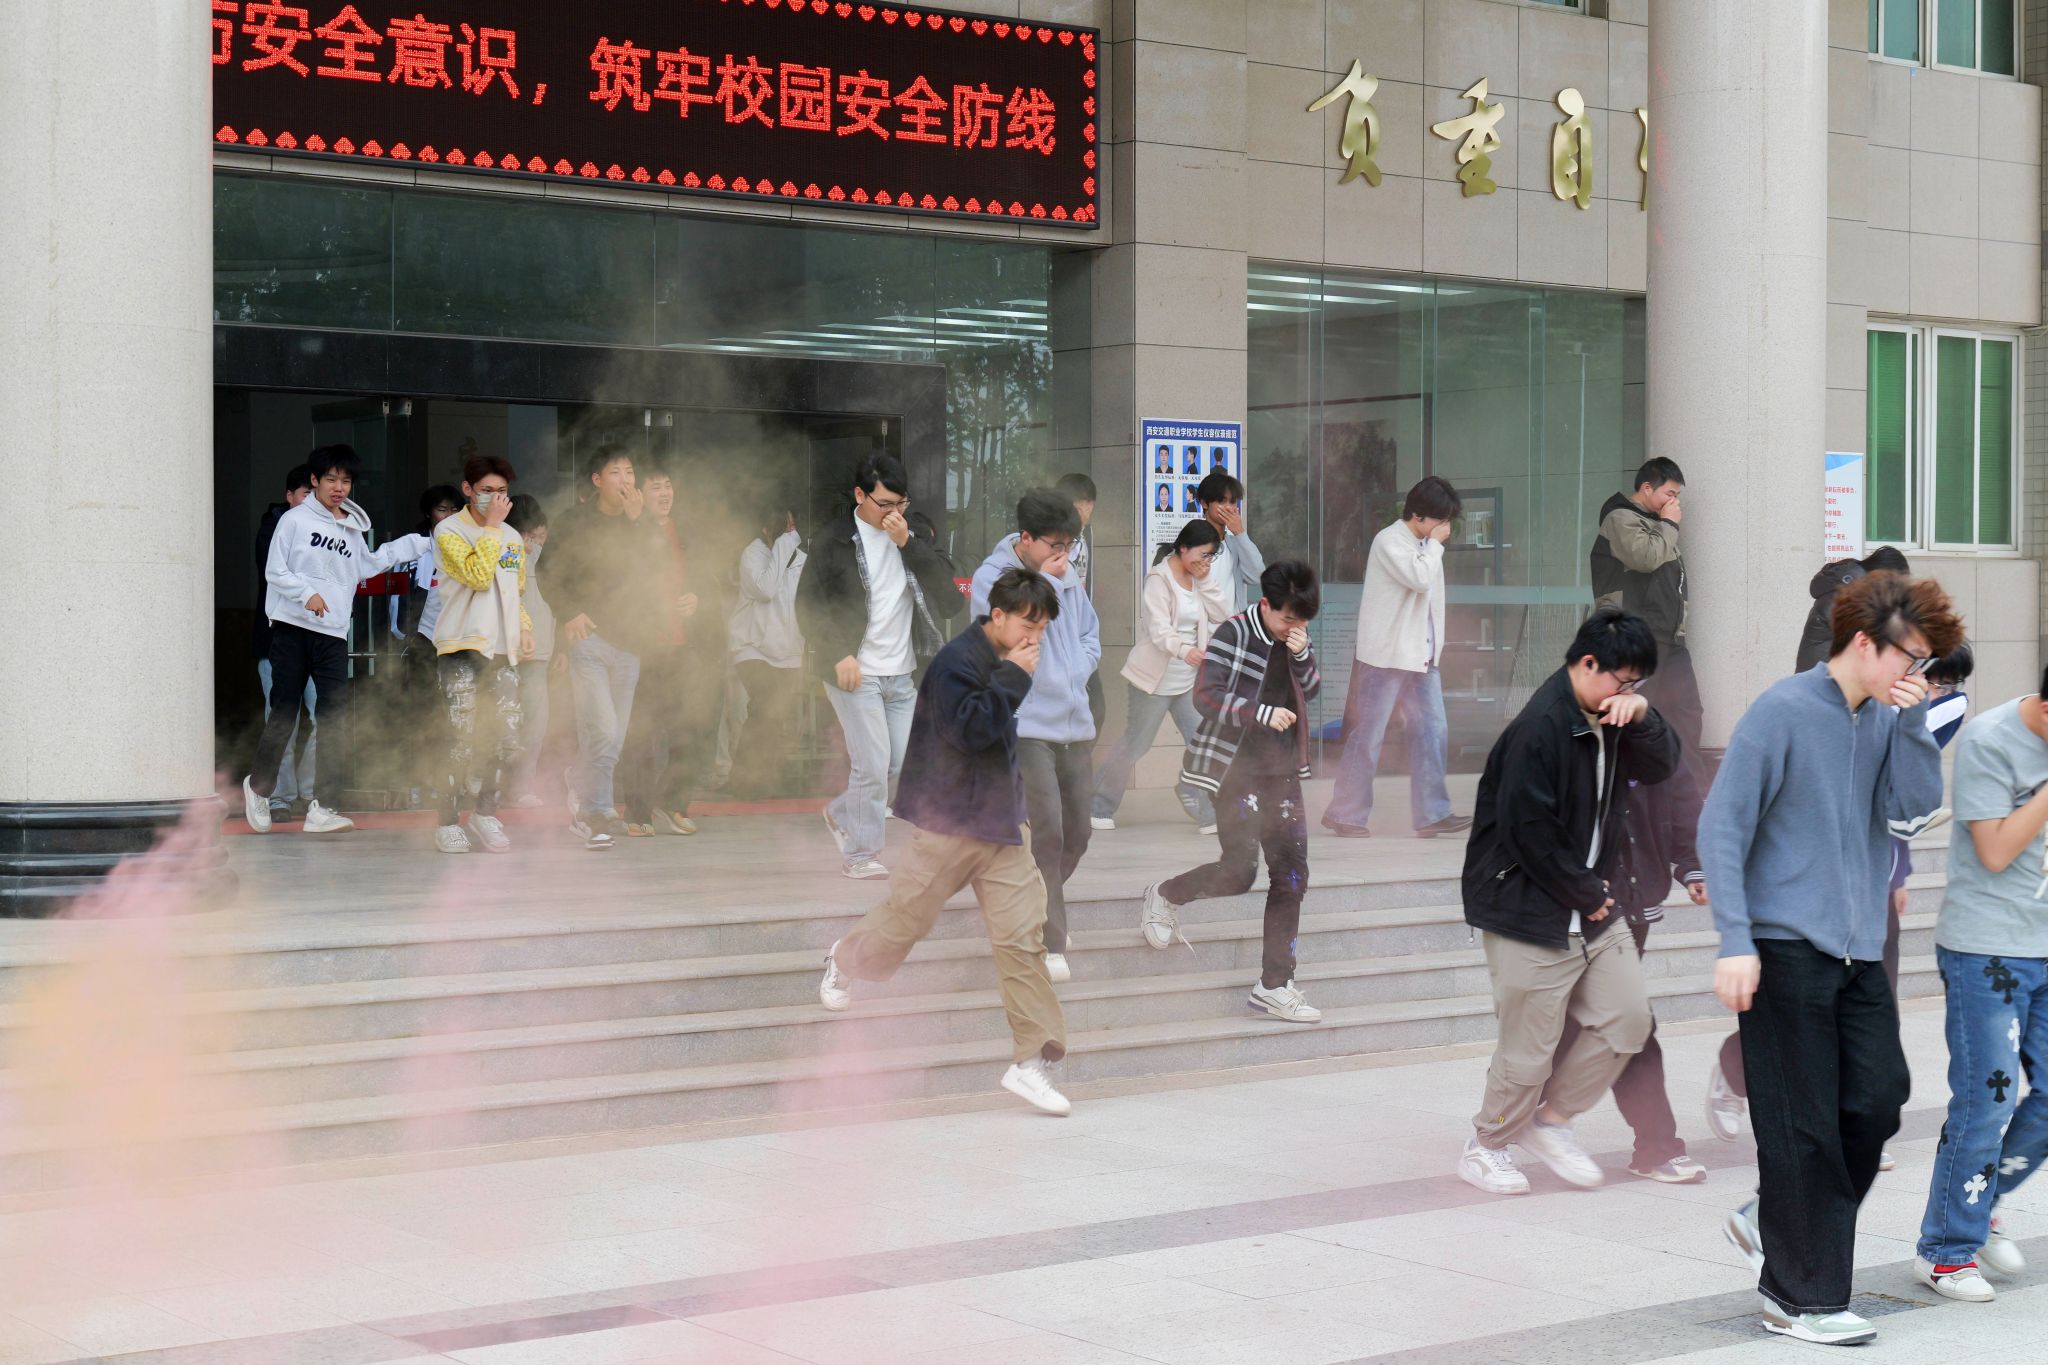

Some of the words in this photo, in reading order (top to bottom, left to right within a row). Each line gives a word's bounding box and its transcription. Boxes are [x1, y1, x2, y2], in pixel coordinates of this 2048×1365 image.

[589, 36, 1056, 155] 筑牢校园安全防线
